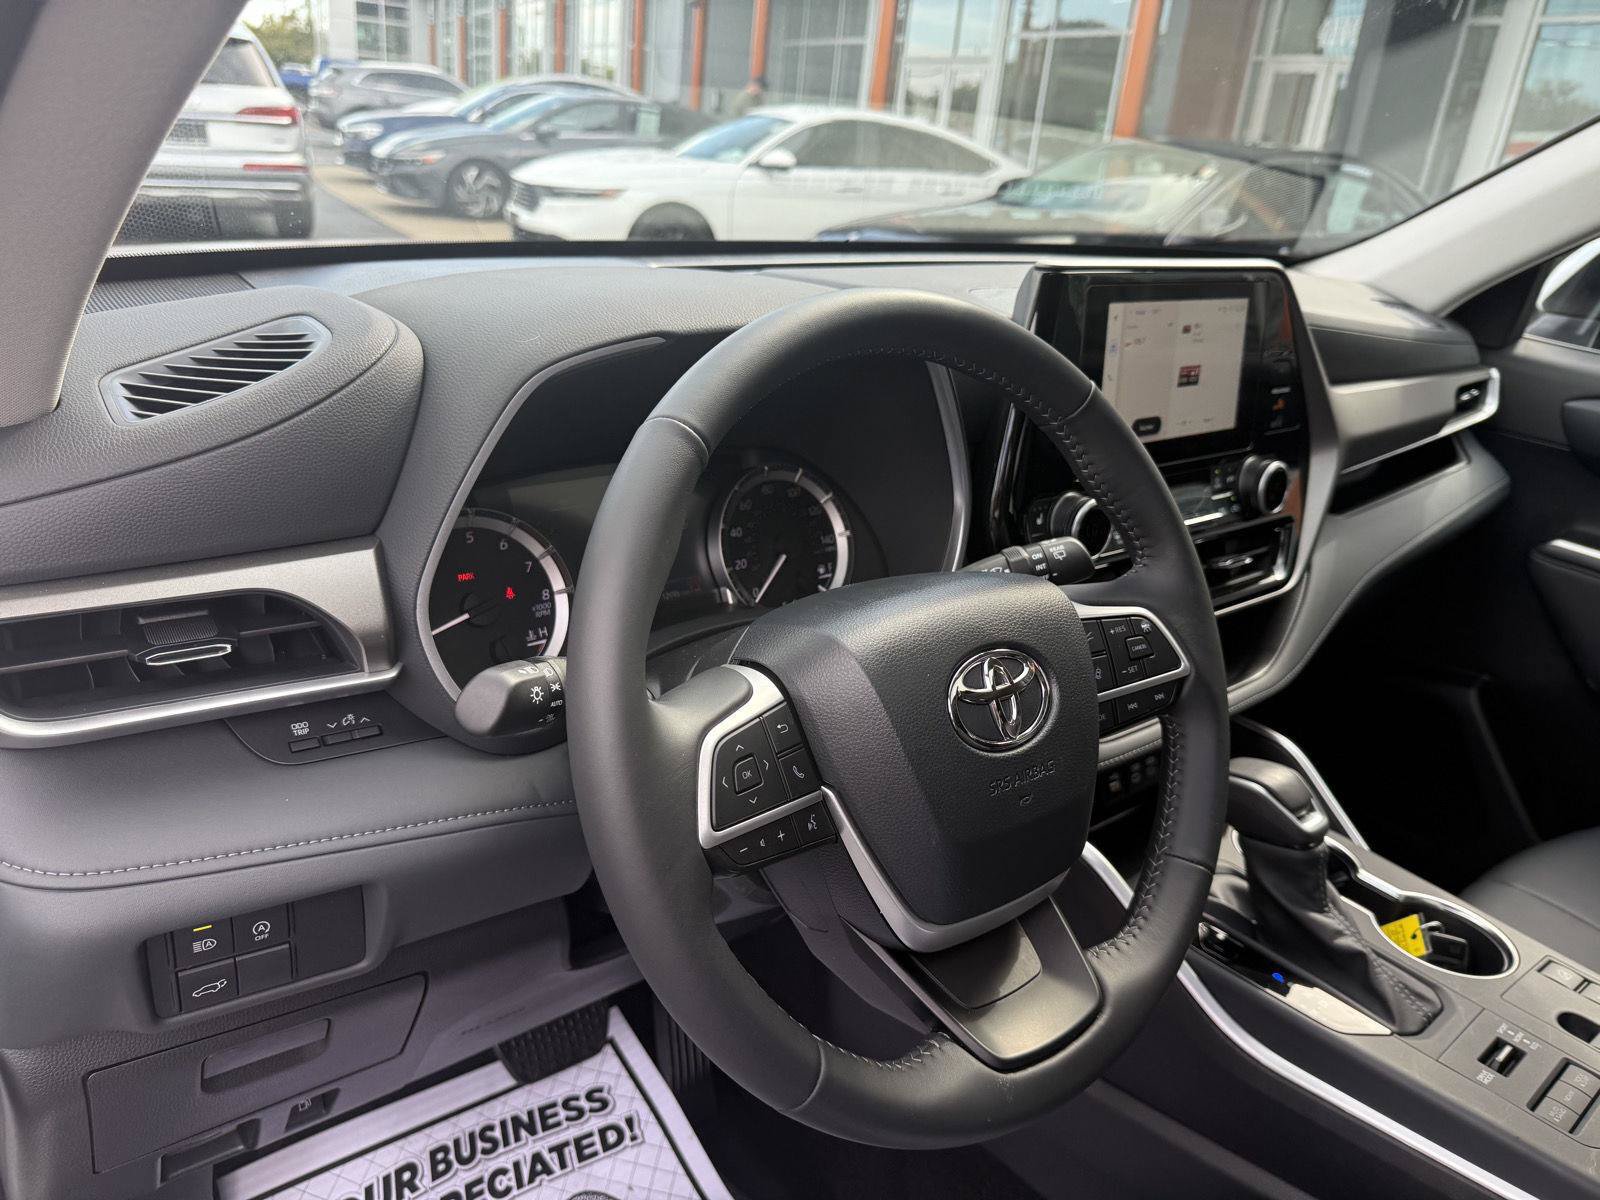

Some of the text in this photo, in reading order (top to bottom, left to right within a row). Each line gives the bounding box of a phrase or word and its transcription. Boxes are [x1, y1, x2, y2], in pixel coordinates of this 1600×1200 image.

[466, 532, 474, 544] 5
[730, 527, 743, 538] 40
[500, 541, 509, 552] 6
[1049, 544, 1065, 554] REAR
[1032, 552, 1045, 561] ON
[525, 562, 533, 573] 7
[735, 559, 748, 570] 20
[1036, 562, 1047, 571] INT
[542, 589, 551, 601] 8
[539, 627, 548, 638] H
[550, 699, 563, 708] AUTO
[290, 721, 309, 730] ODO
[292, 728, 310, 737] TRIP
[741, 769, 754, 780] OK
[989, 760, 1057, 798] SRS AIRBAG
[255, 934, 270, 942] OFF
[428, 1086, 613, 1182] BUSINESS
